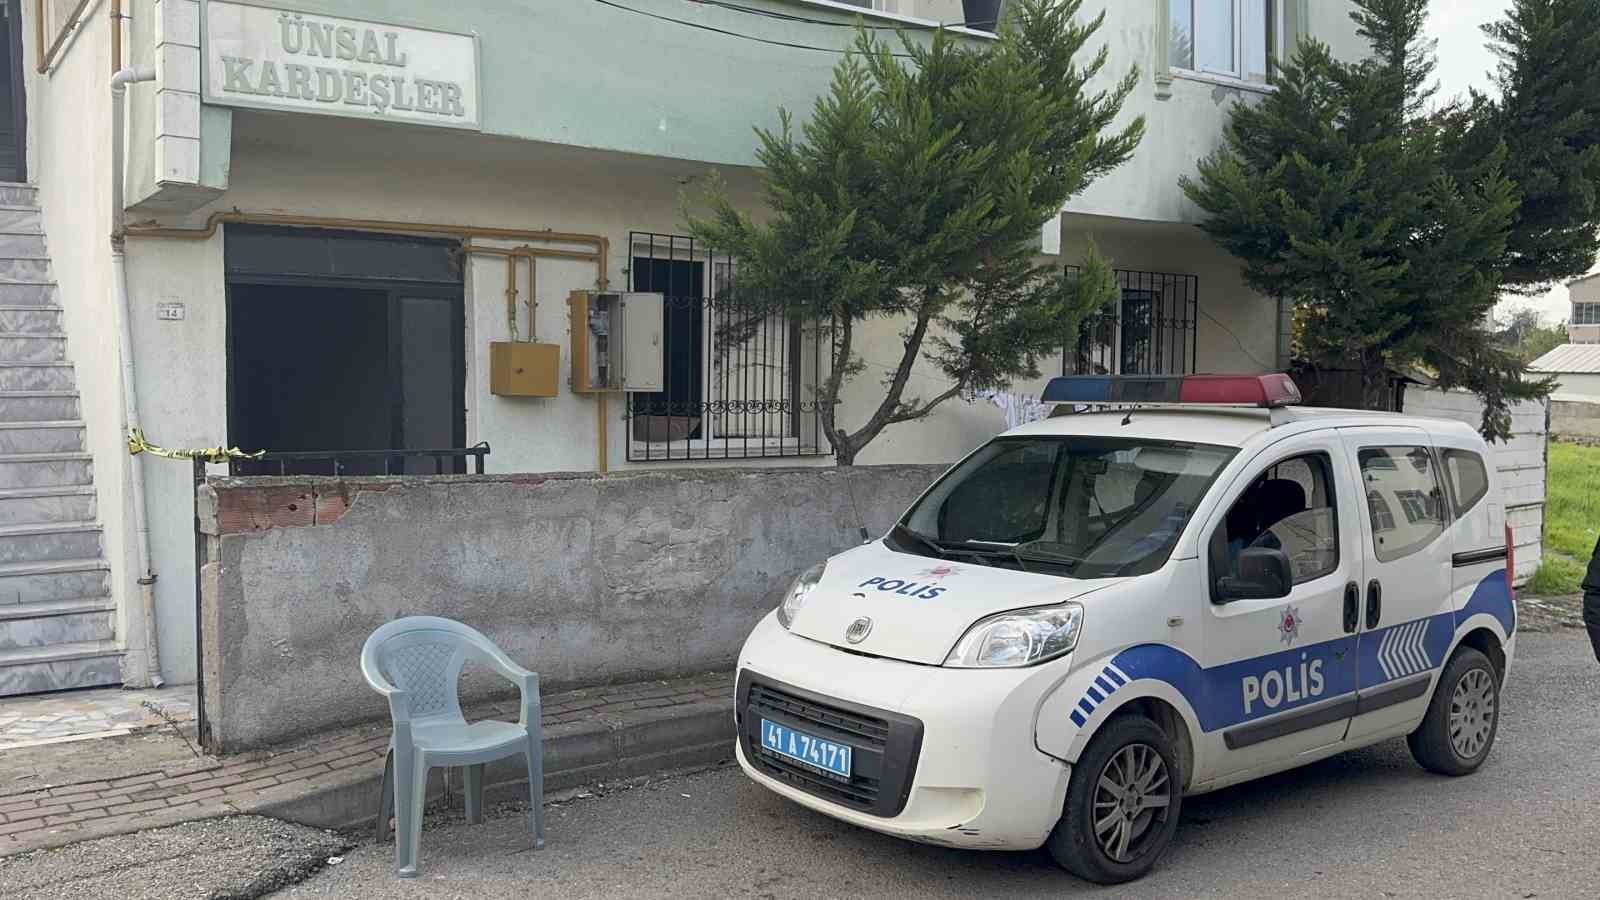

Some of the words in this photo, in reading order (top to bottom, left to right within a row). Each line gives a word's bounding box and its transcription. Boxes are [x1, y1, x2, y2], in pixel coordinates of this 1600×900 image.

[279, 13, 406, 67] ÜNSAL
[221, 56, 464, 115] KARDEŞLER
[859, 577, 946, 598] POLİS
[1242, 652, 1324, 714] POLİS
[768, 725, 782, 749] 41
[789, 732, 797, 754] A
[801, 736, 847, 771] 74171
